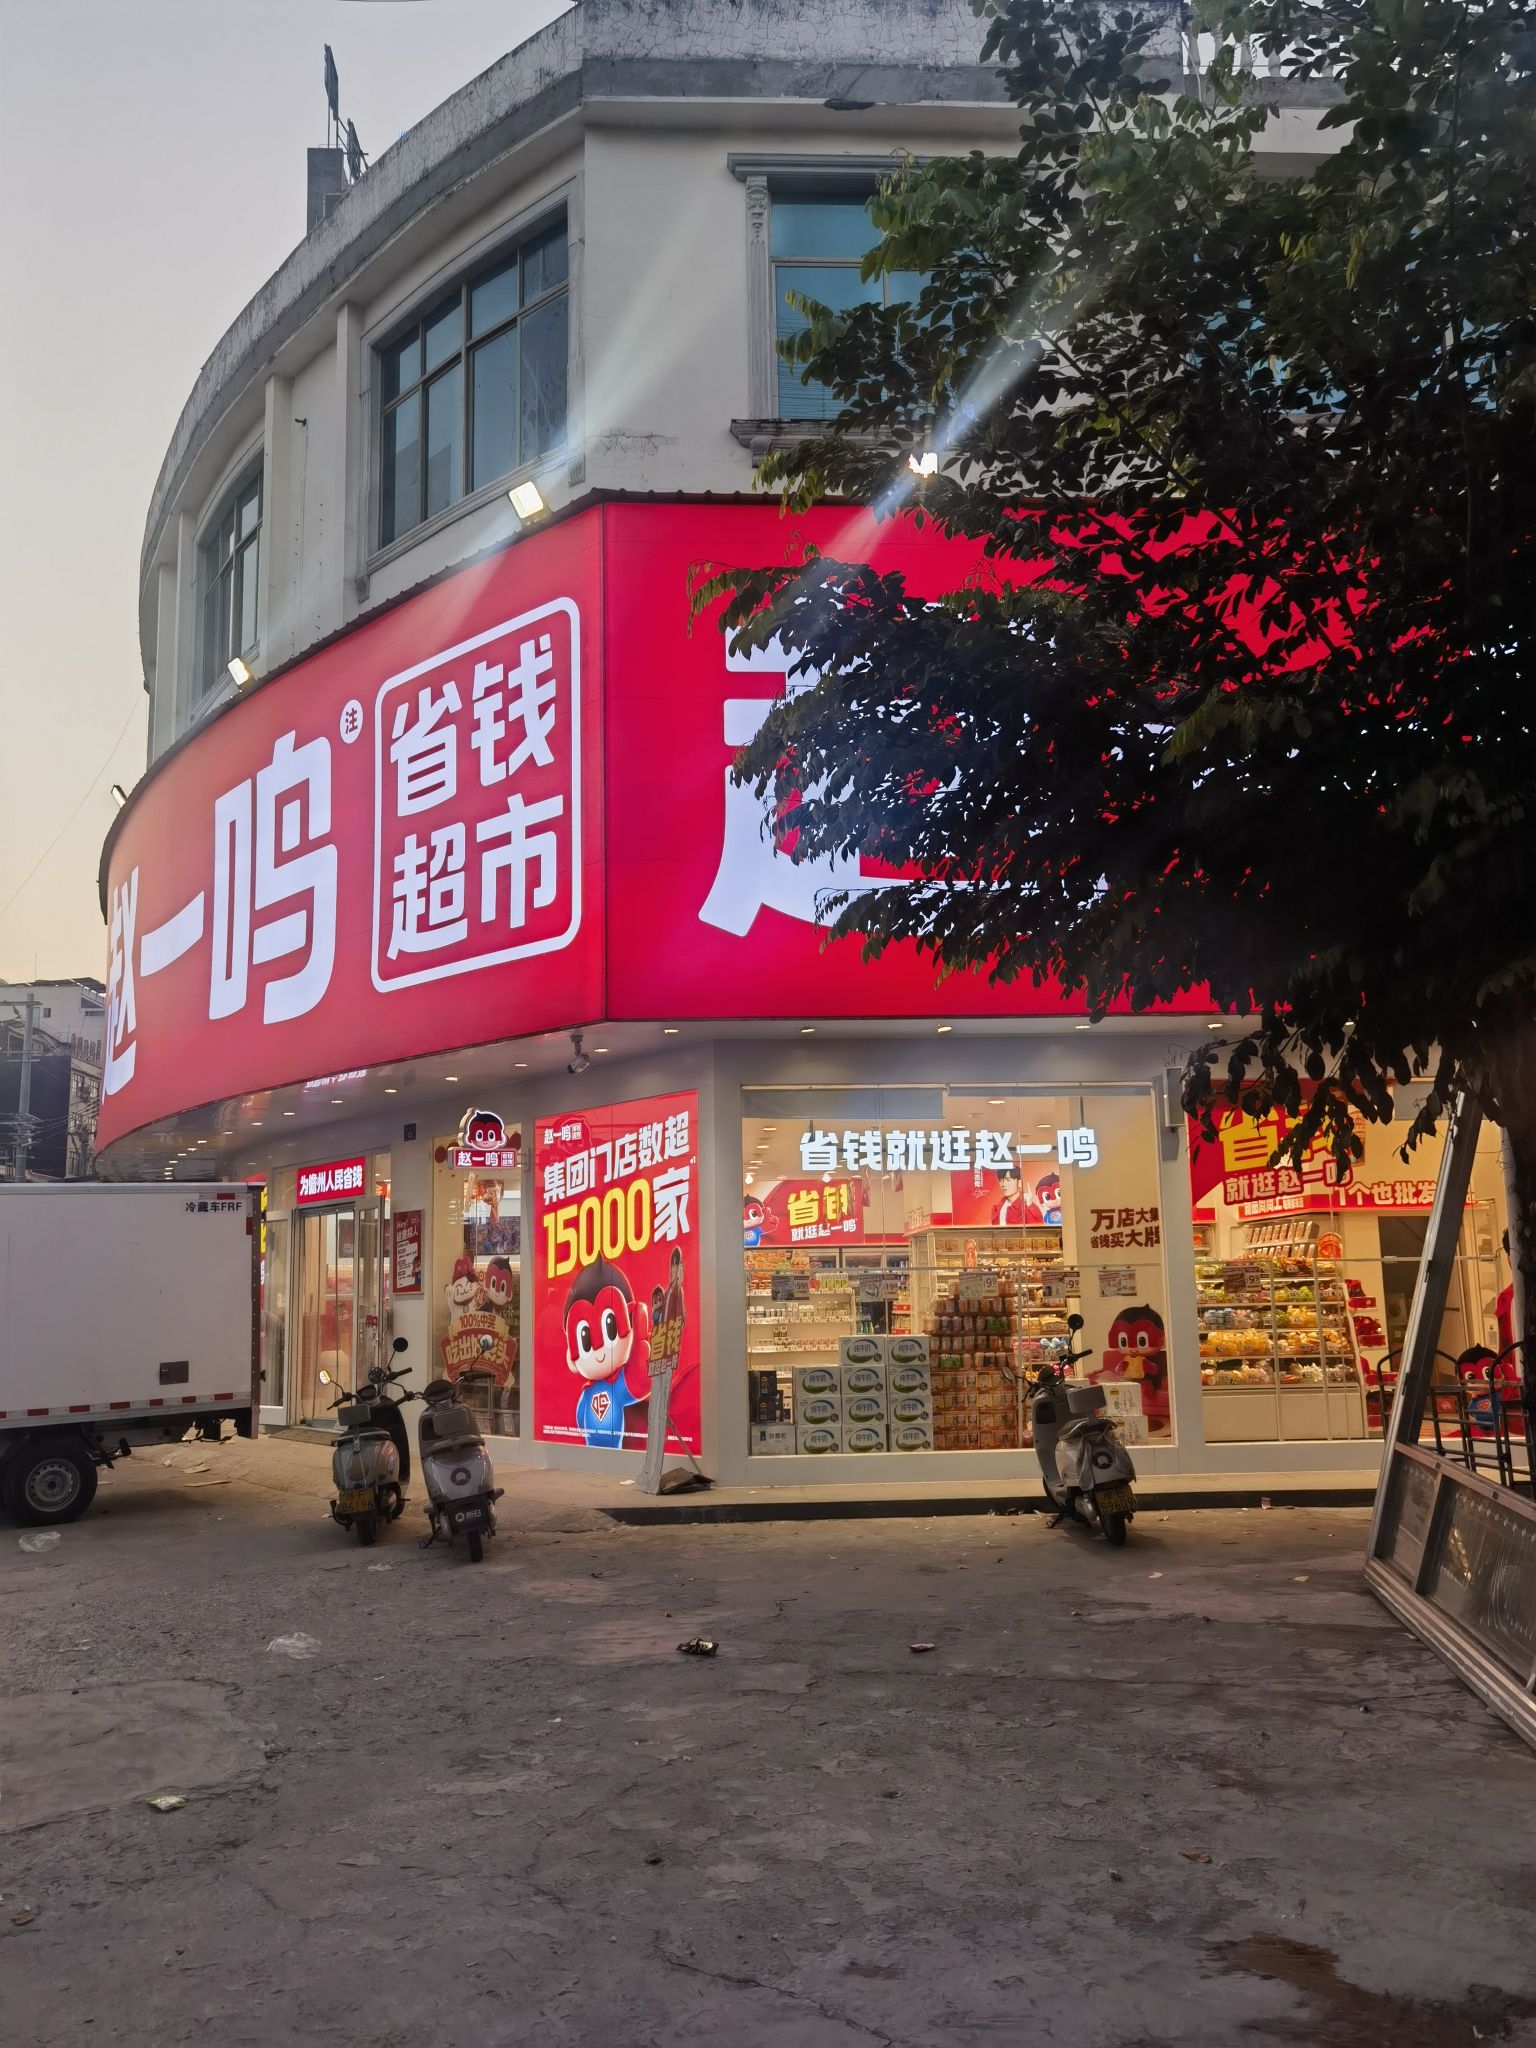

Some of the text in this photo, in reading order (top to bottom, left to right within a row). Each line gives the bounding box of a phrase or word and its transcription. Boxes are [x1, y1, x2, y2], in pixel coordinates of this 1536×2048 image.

[389, 632, 557, 818] 省钱
[103, 729, 338, 1096] 赵一鸣
[386, 792, 564, 961] 超市
[300, 1164, 363, 1197] 为儋州人民省钱
[457, 1151, 499, 1167] 赵一鸣
[543, 1124, 571, 1145] 赵一鸣
[543, 1110, 690, 1206] 集团门店数超
[799, 1127, 1099, 1171] 省钱就逛赵一鸣
[543, 1165, 690, 1279] 15000家
